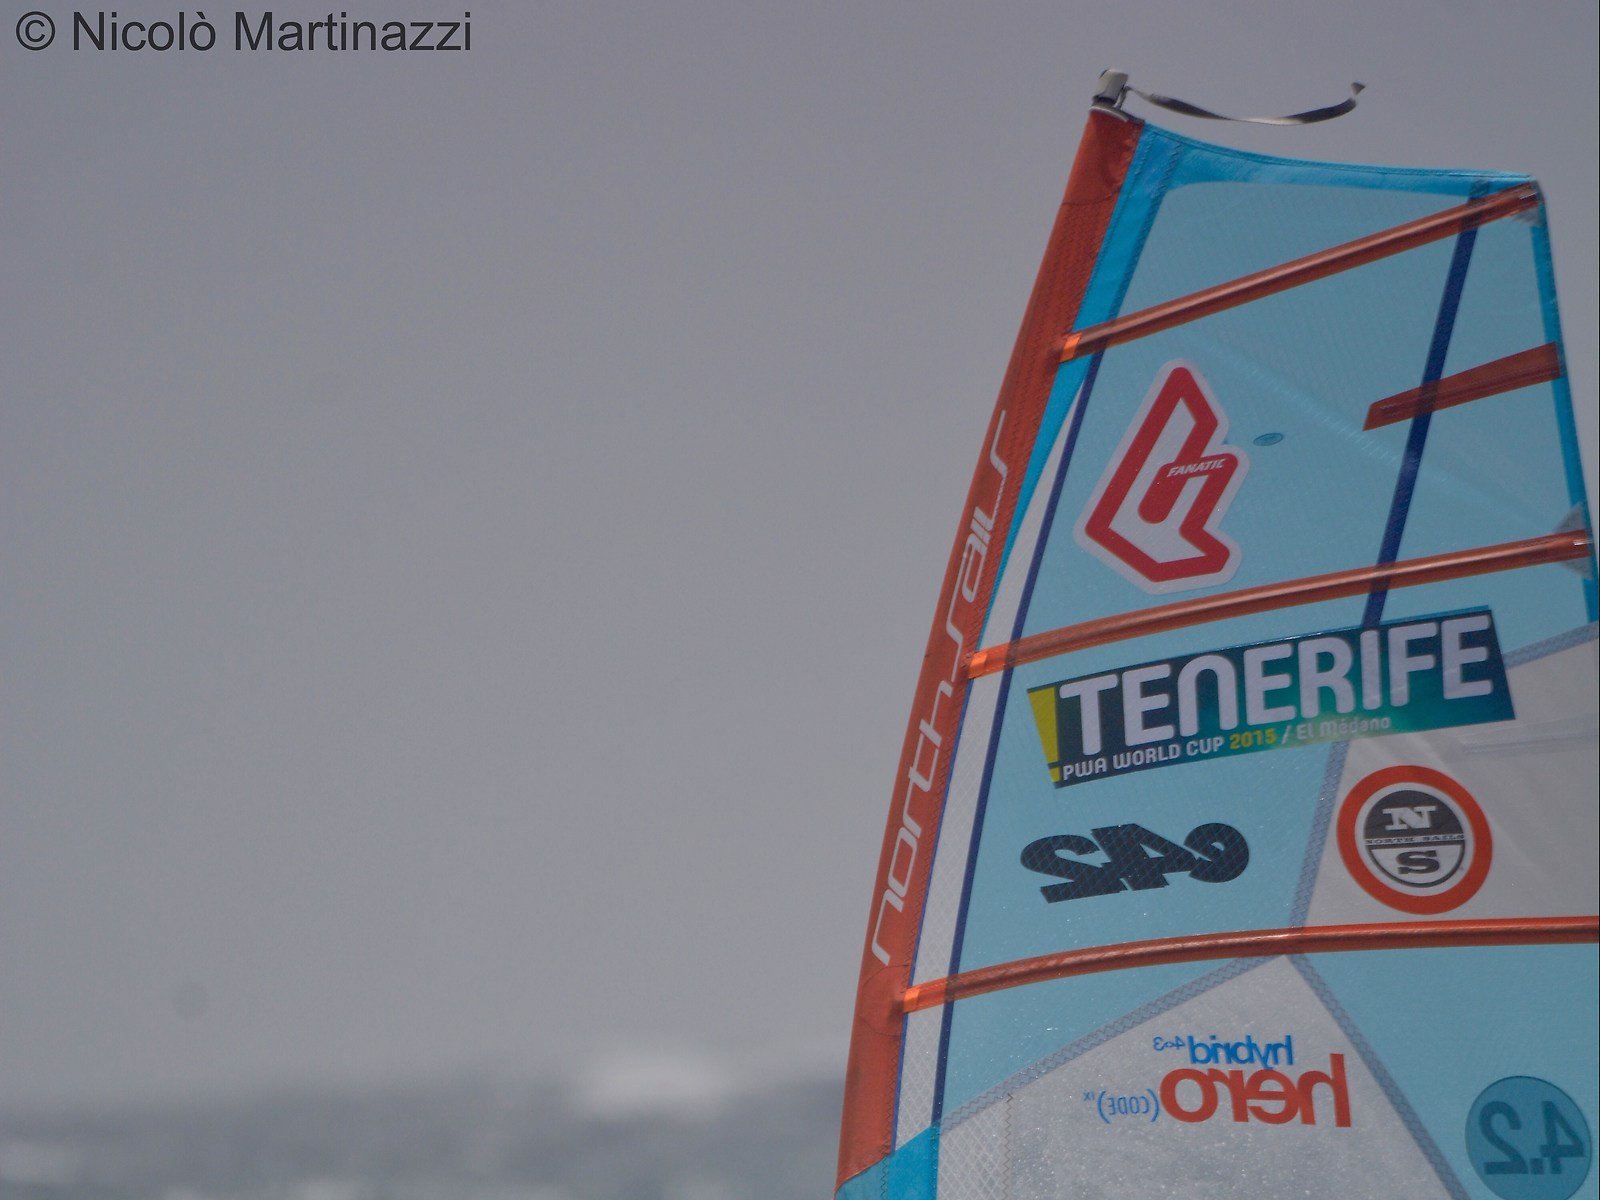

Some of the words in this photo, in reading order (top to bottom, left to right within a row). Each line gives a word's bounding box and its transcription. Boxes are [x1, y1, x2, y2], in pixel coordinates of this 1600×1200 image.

[1166, 458, 1227, 478] FANATIC
[1058, 614, 1494, 756] TENERIFE
[1062, 757, 1108, 781] PWA
[1112, 742, 1181, 770] WORLD
[1186, 735, 1225, 757] CUP
[1229, 728, 1277, 750] 2015
[1296, 722, 1314, 741] El
[1319, 716, 1391, 738] Médano
